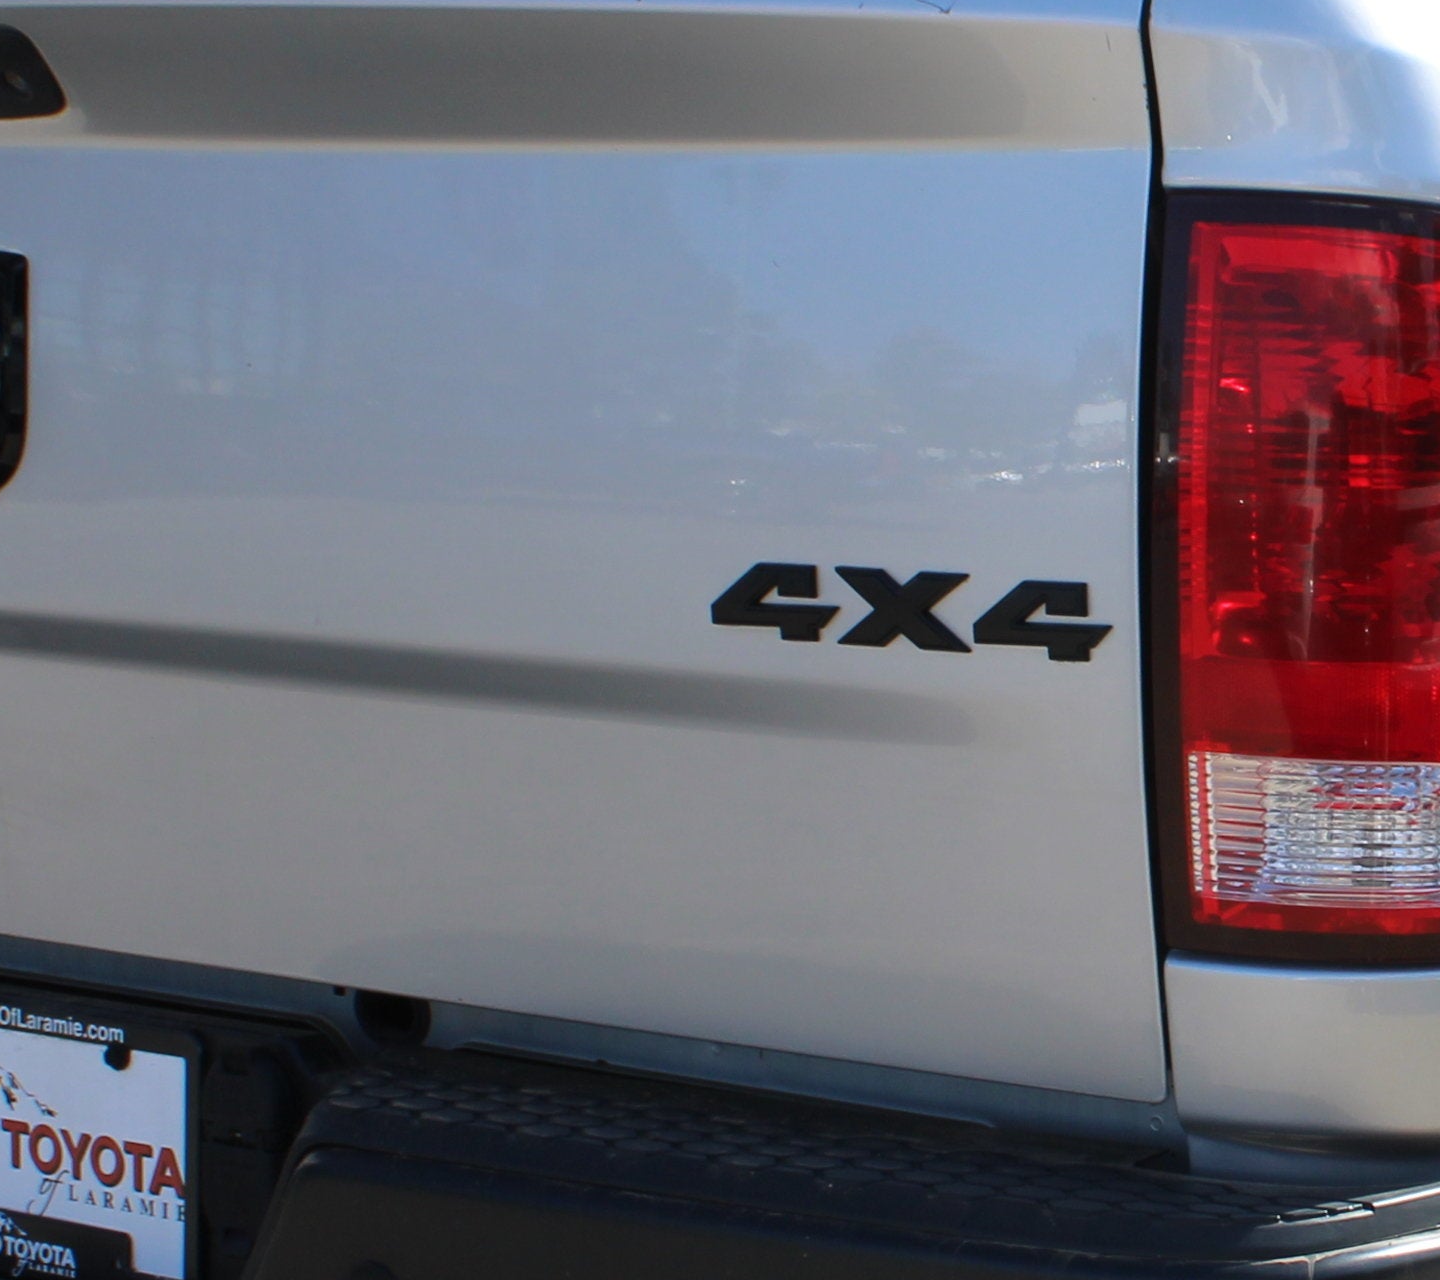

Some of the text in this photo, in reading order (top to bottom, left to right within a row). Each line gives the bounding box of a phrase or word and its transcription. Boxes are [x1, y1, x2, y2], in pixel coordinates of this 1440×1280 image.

[711, 562, 1114, 662] 4X4
[0, 1118, 187, 1200] TOYOTA
[3, 1234, 76, 1270] TOYOTA
